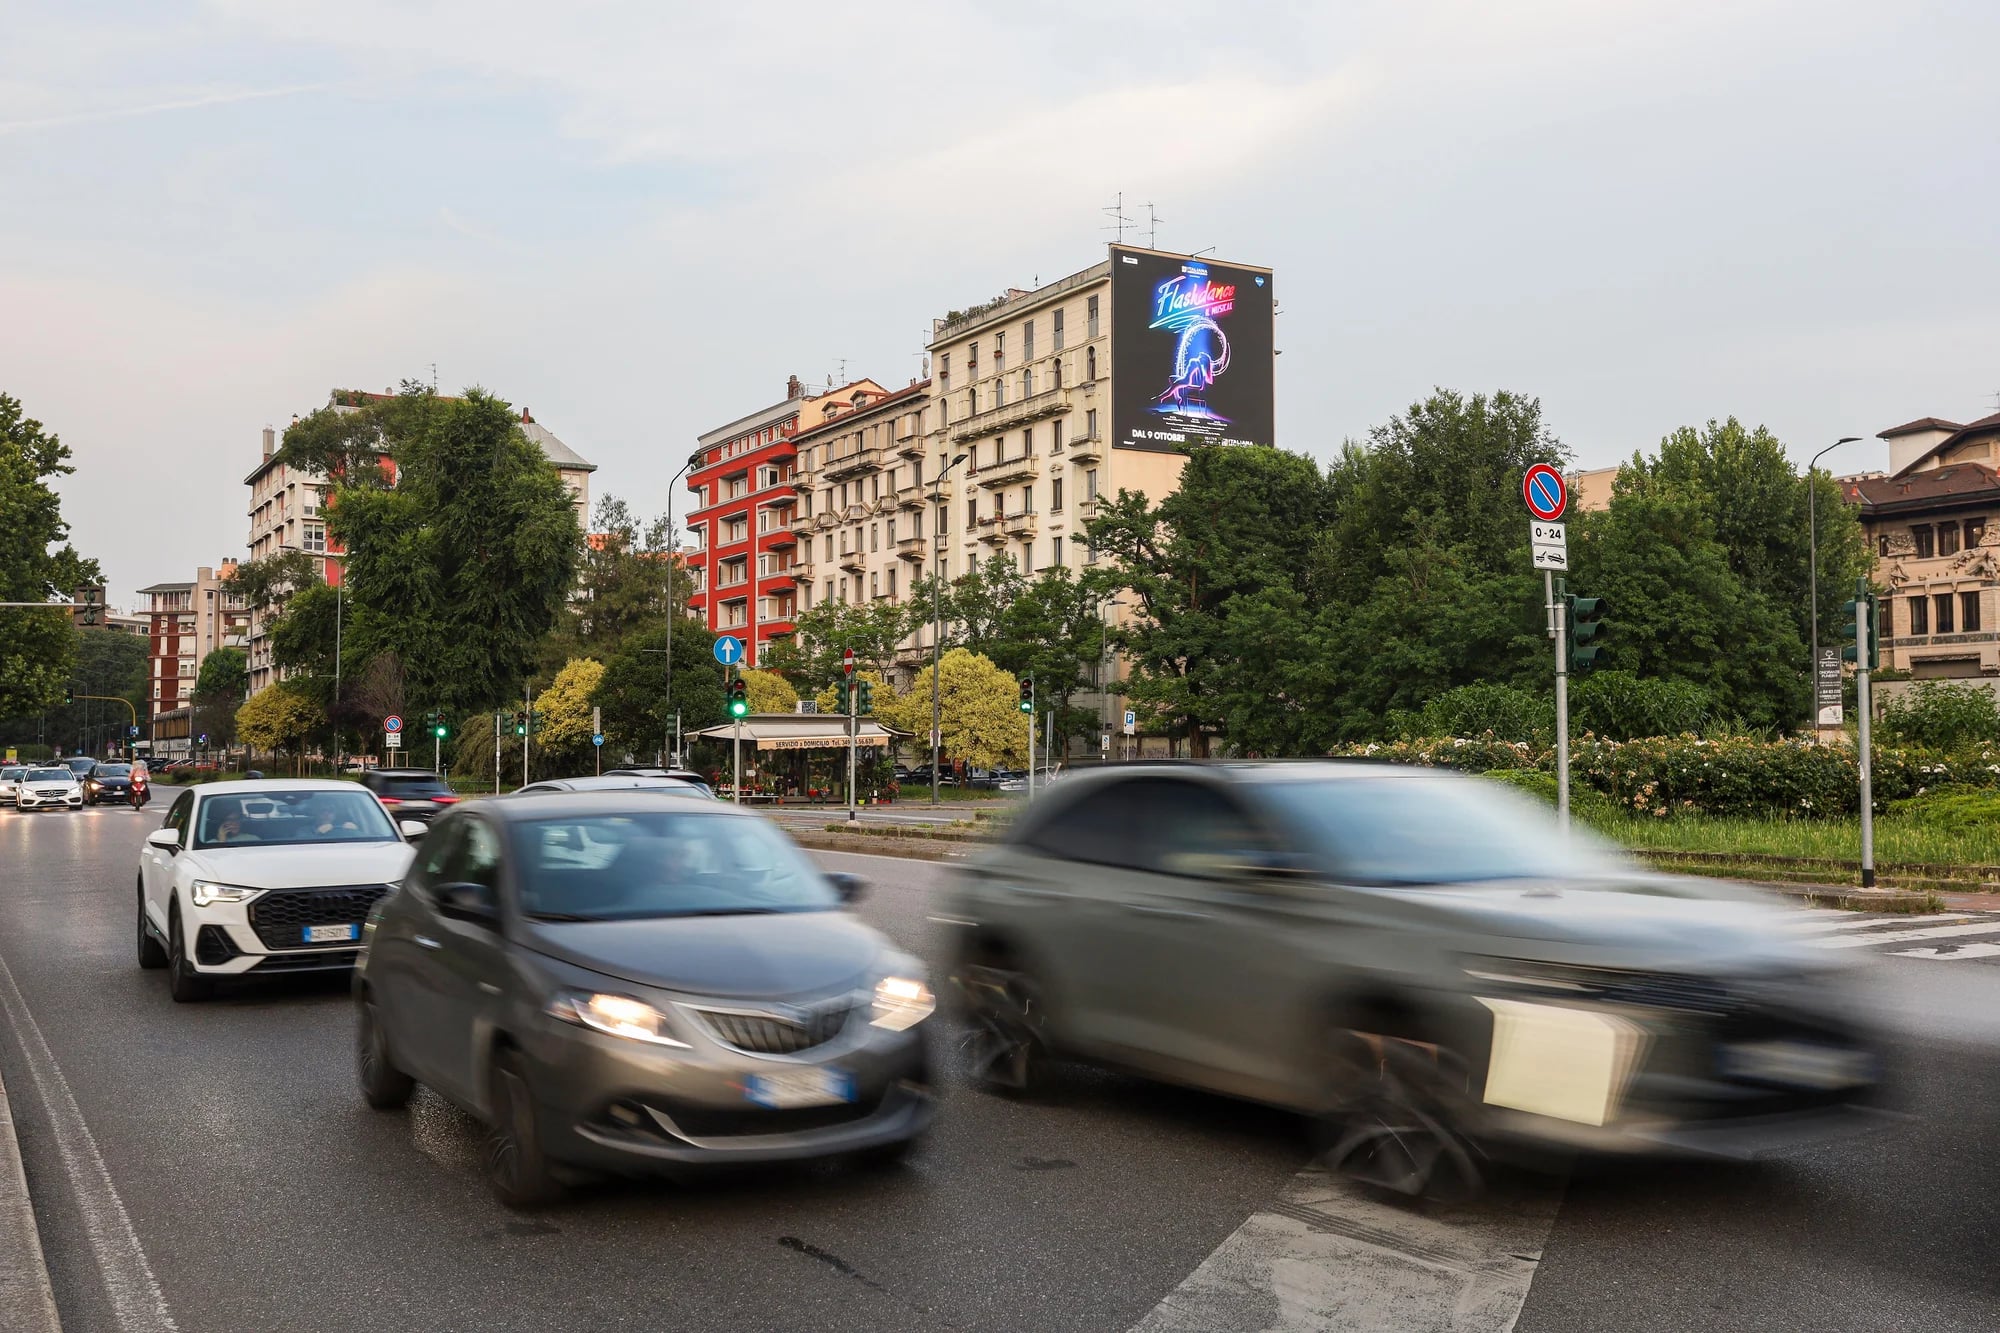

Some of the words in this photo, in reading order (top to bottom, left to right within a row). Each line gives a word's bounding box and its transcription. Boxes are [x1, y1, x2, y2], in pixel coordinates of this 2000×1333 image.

[1157, 276, 1235, 316] Flashdance
[1212, 302, 1233, 314] MUSICAL
[1132, 429, 1146, 439] DAL
[1147, 431, 1153, 440] 9
[1154, 432, 1185, 442] OTTOBRE
